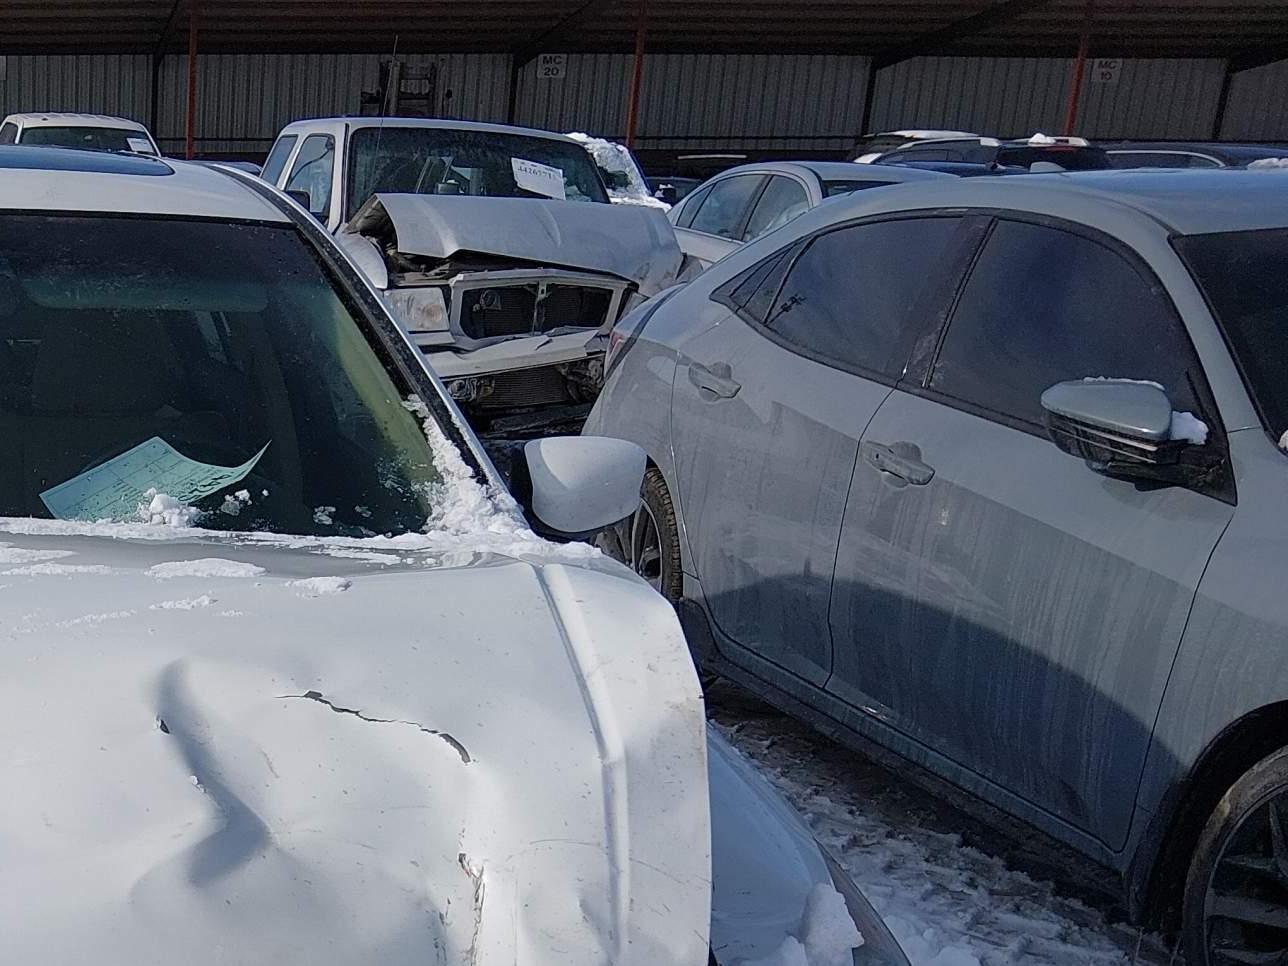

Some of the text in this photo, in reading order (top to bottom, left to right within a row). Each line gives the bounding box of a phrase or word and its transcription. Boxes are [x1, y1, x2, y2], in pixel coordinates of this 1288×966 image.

[542, 56, 563, 65] MC
[1097, 60, 1117, 69] MC
[543, 67, 560, 76] 20
[1100, 71, 1113, 81] 10
